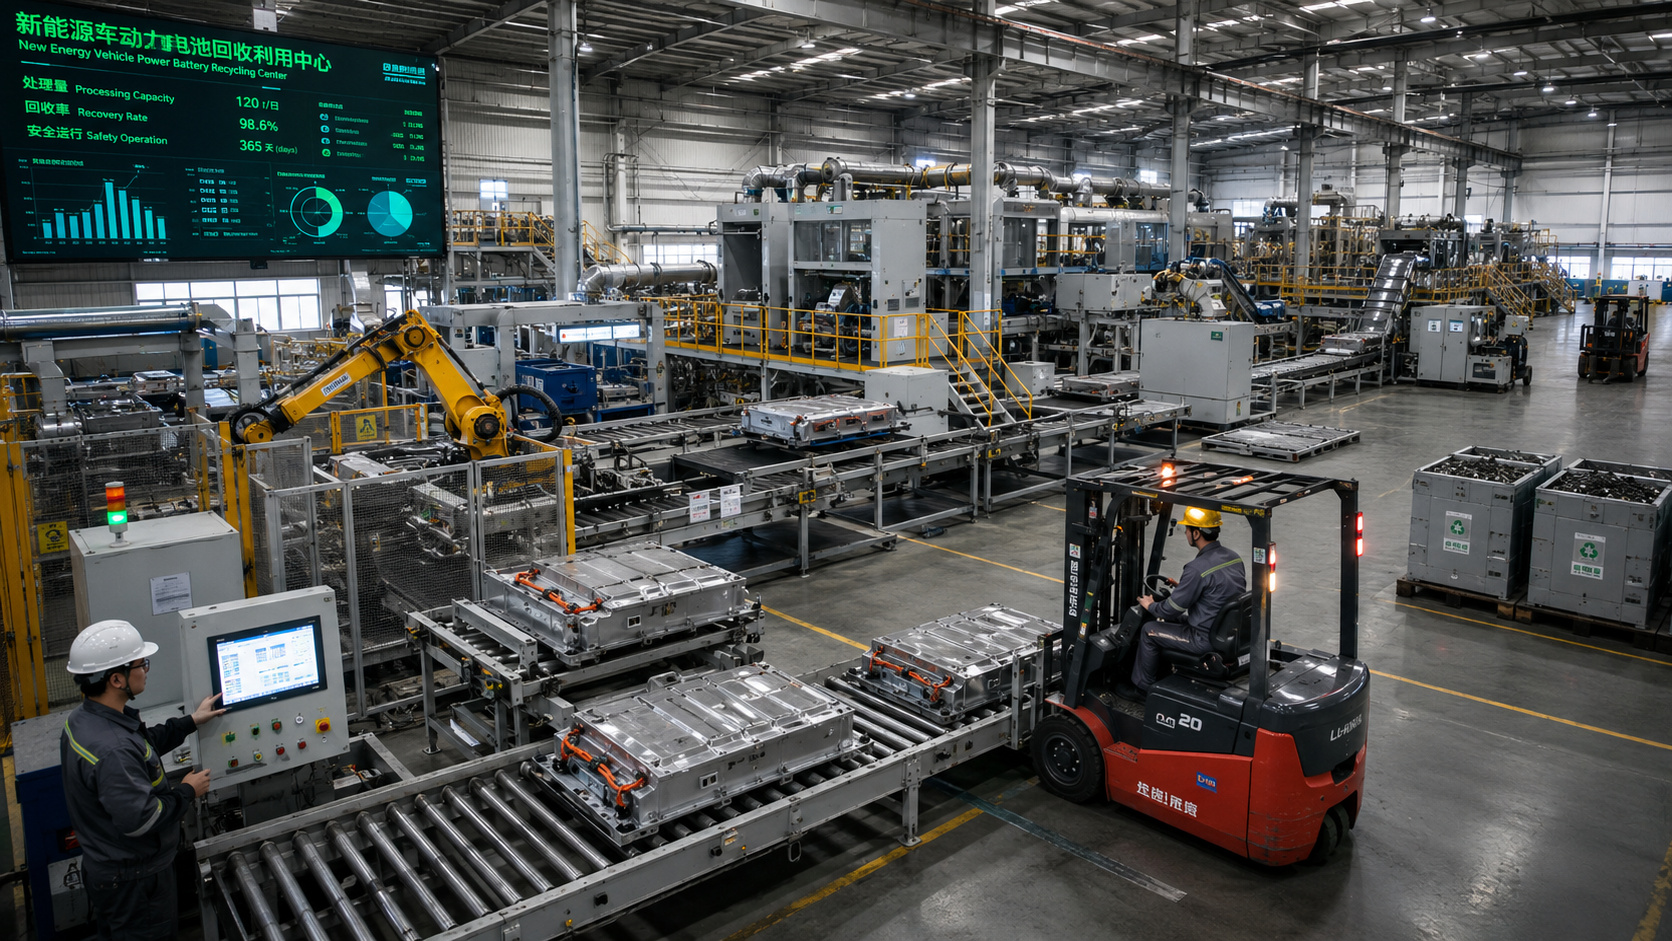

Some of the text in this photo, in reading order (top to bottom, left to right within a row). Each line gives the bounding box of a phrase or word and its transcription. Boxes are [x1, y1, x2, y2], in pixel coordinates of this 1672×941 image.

[19, 39, 287, 80] New Energy Vehicle Power Battery Recycling Center
[22, 75, 68, 93] 处理量
[75, 84, 175, 105] Processing Capacity
[25, 100, 70, 116] 回收率
[236, 96, 259, 109] 120
[78, 107, 148, 122] Recovery Rate
[239, 117, 279, 132] 98.6%
[86, 131, 168, 145] Safety Operation
[240, 139, 262, 152] 365
[265, 143, 274, 152] 天
[1178, 713, 1203, 732] 20
